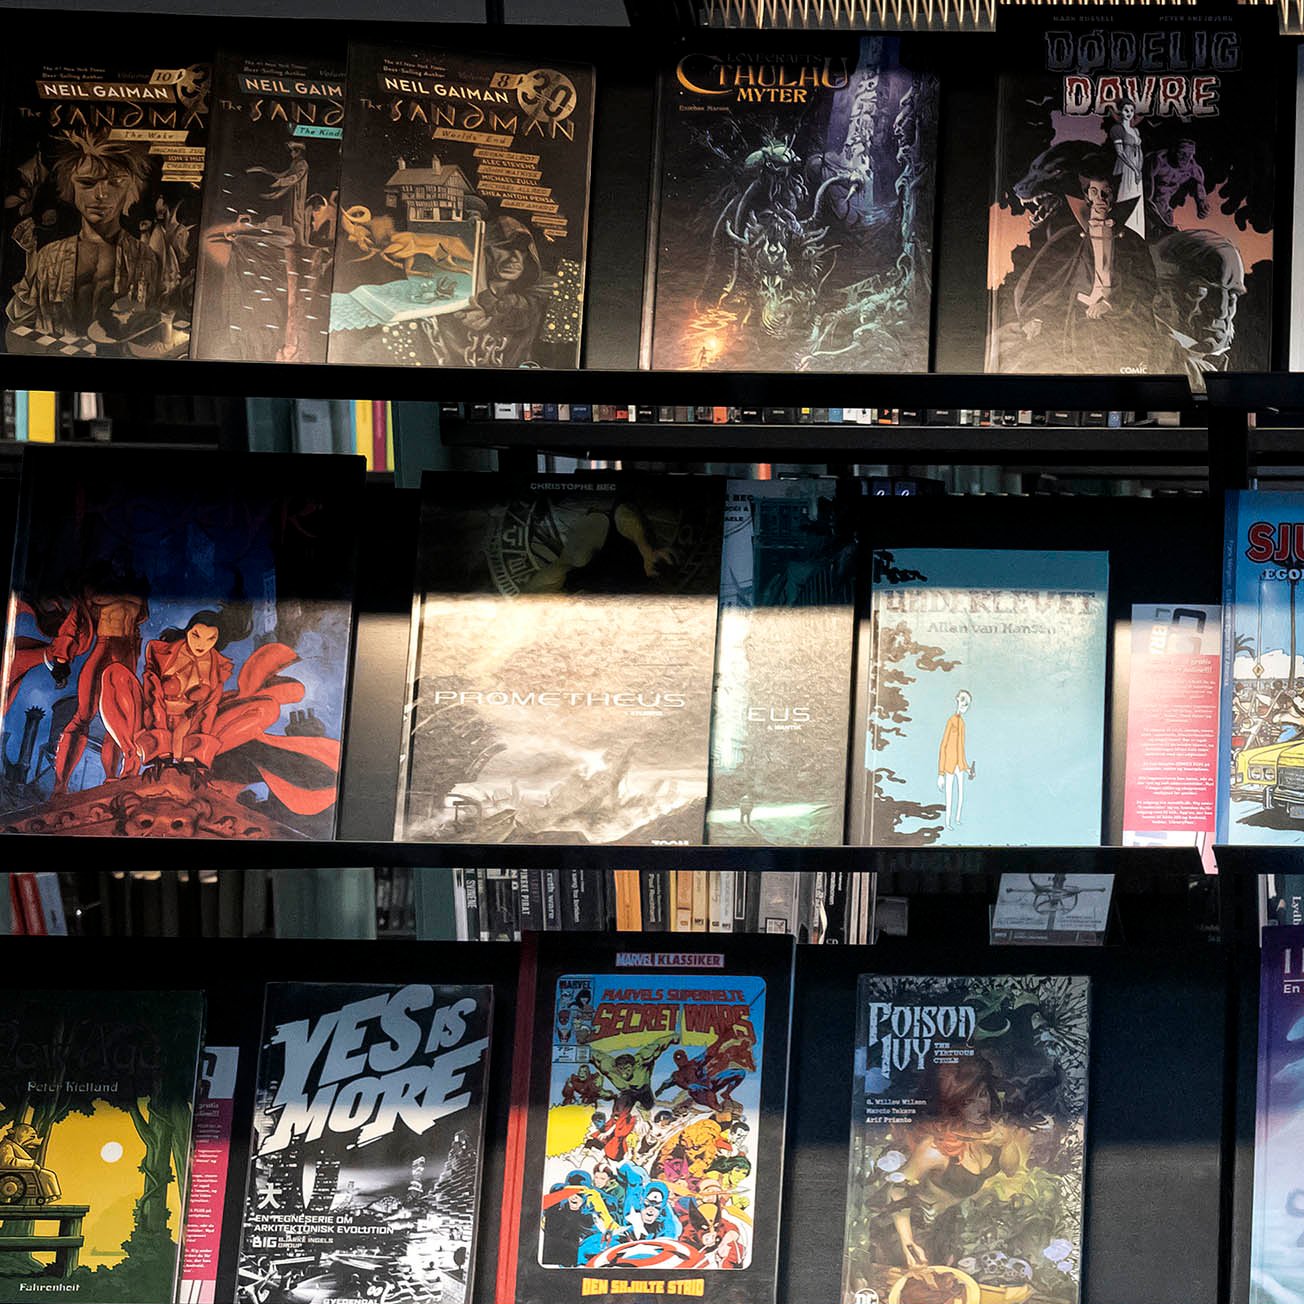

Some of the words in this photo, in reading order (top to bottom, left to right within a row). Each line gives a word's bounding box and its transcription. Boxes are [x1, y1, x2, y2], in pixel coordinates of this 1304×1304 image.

[1044, 30, 1241, 73] DØDELIG
[155, 72, 171, 81] 10
[246, 78, 290, 93] NEIL
[44, 84, 89, 97] NEIL
[93, 86, 168, 99] GAIMAN
[385, 77, 429, 95] NEIL
[434, 84, 509, 104] GAIMAN
[737, 87, 807, 104] MYTER
[1064, 75, 1221, 118] DAVRE
[529, 482, 594, 491] CHRISTOPHE
[596, 483, 616, 491] BEC
[434, 690, 687, 708] PROMETHEUS
[657, 954, 721, 966] KLASSIKER
[1284, 949, 1291, 974] I
[1283, 983, 1300, 994] En
[268, 983, 435, 1085] YES
[424, 997, 478, 1054] IS
[588, 1004, 680, 1044] SECRET
[683, 1004, 757, 1043] WARS
[868, 1002, 977, 1048] POISON
[881, 1033, 931, 1080] IVY
[252, 1036, 490, 1160] MORE
[253, 1224, 335, 1234] ARKITEKTONISK
[336, 1226, 394, 1235] EVOLUTION
